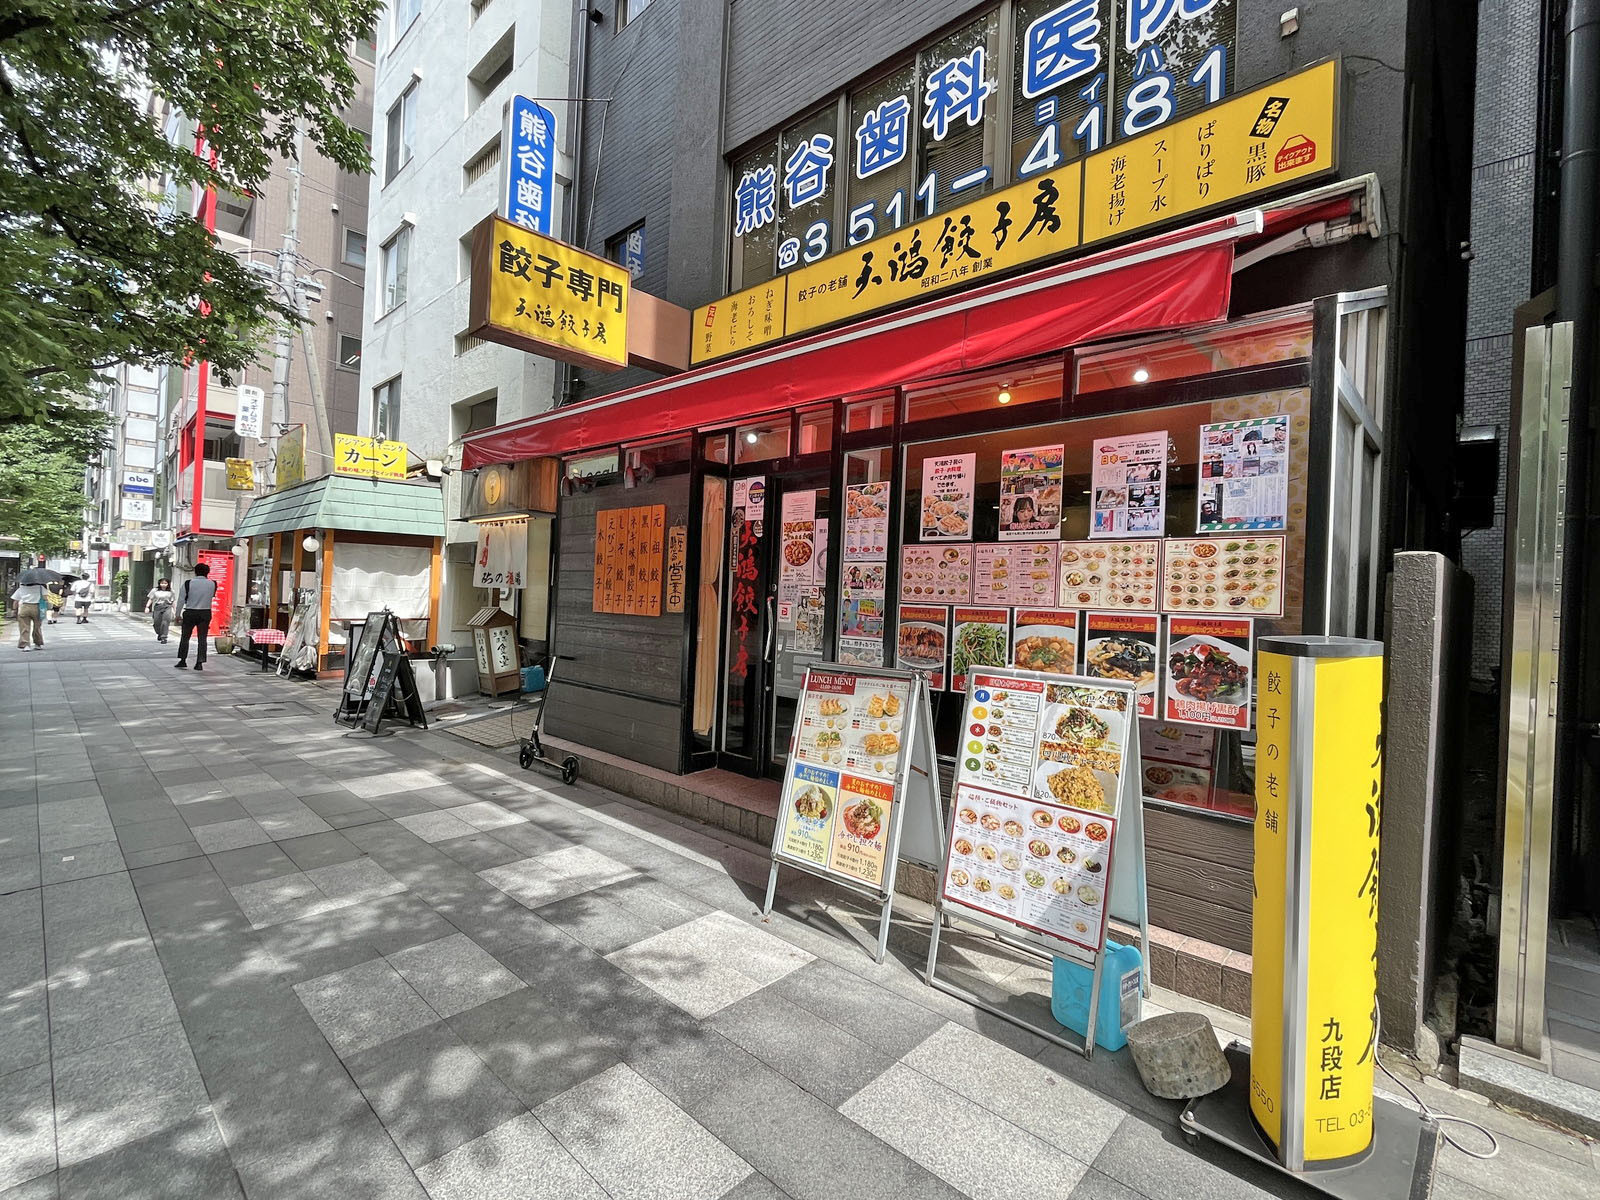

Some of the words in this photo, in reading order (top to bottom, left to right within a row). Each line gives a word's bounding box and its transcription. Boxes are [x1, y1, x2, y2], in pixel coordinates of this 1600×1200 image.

[1254, 99, 1283, 136] 名物
[1149, 139, 1168, 213] スープ水
[1196, 119, 1217, 199] ぱりぱり
[1246, 142, 1267, 185] 黒豚
[1277, 154, 1312, 171] 出来ます
[1108, 155, 1127, 226] 海老揚げ
[499, 239, 623, 314] 餃子専門
[798, 274, 849, 302] 餃子の老舗
[128, 475, 150, 483] abc
[344, 447, 399, 468] カーン
[668, 560, 684, 607] 営業中
[810, 674, 833, 685] LUNCH
[833, 676, 855, 687] MENU
[1264, 670, 1282, 835] 餃子の老舗
[1319, 1016, 1344, 1101] 九段店
[1315, 1116, 1345, 1134] TEL
